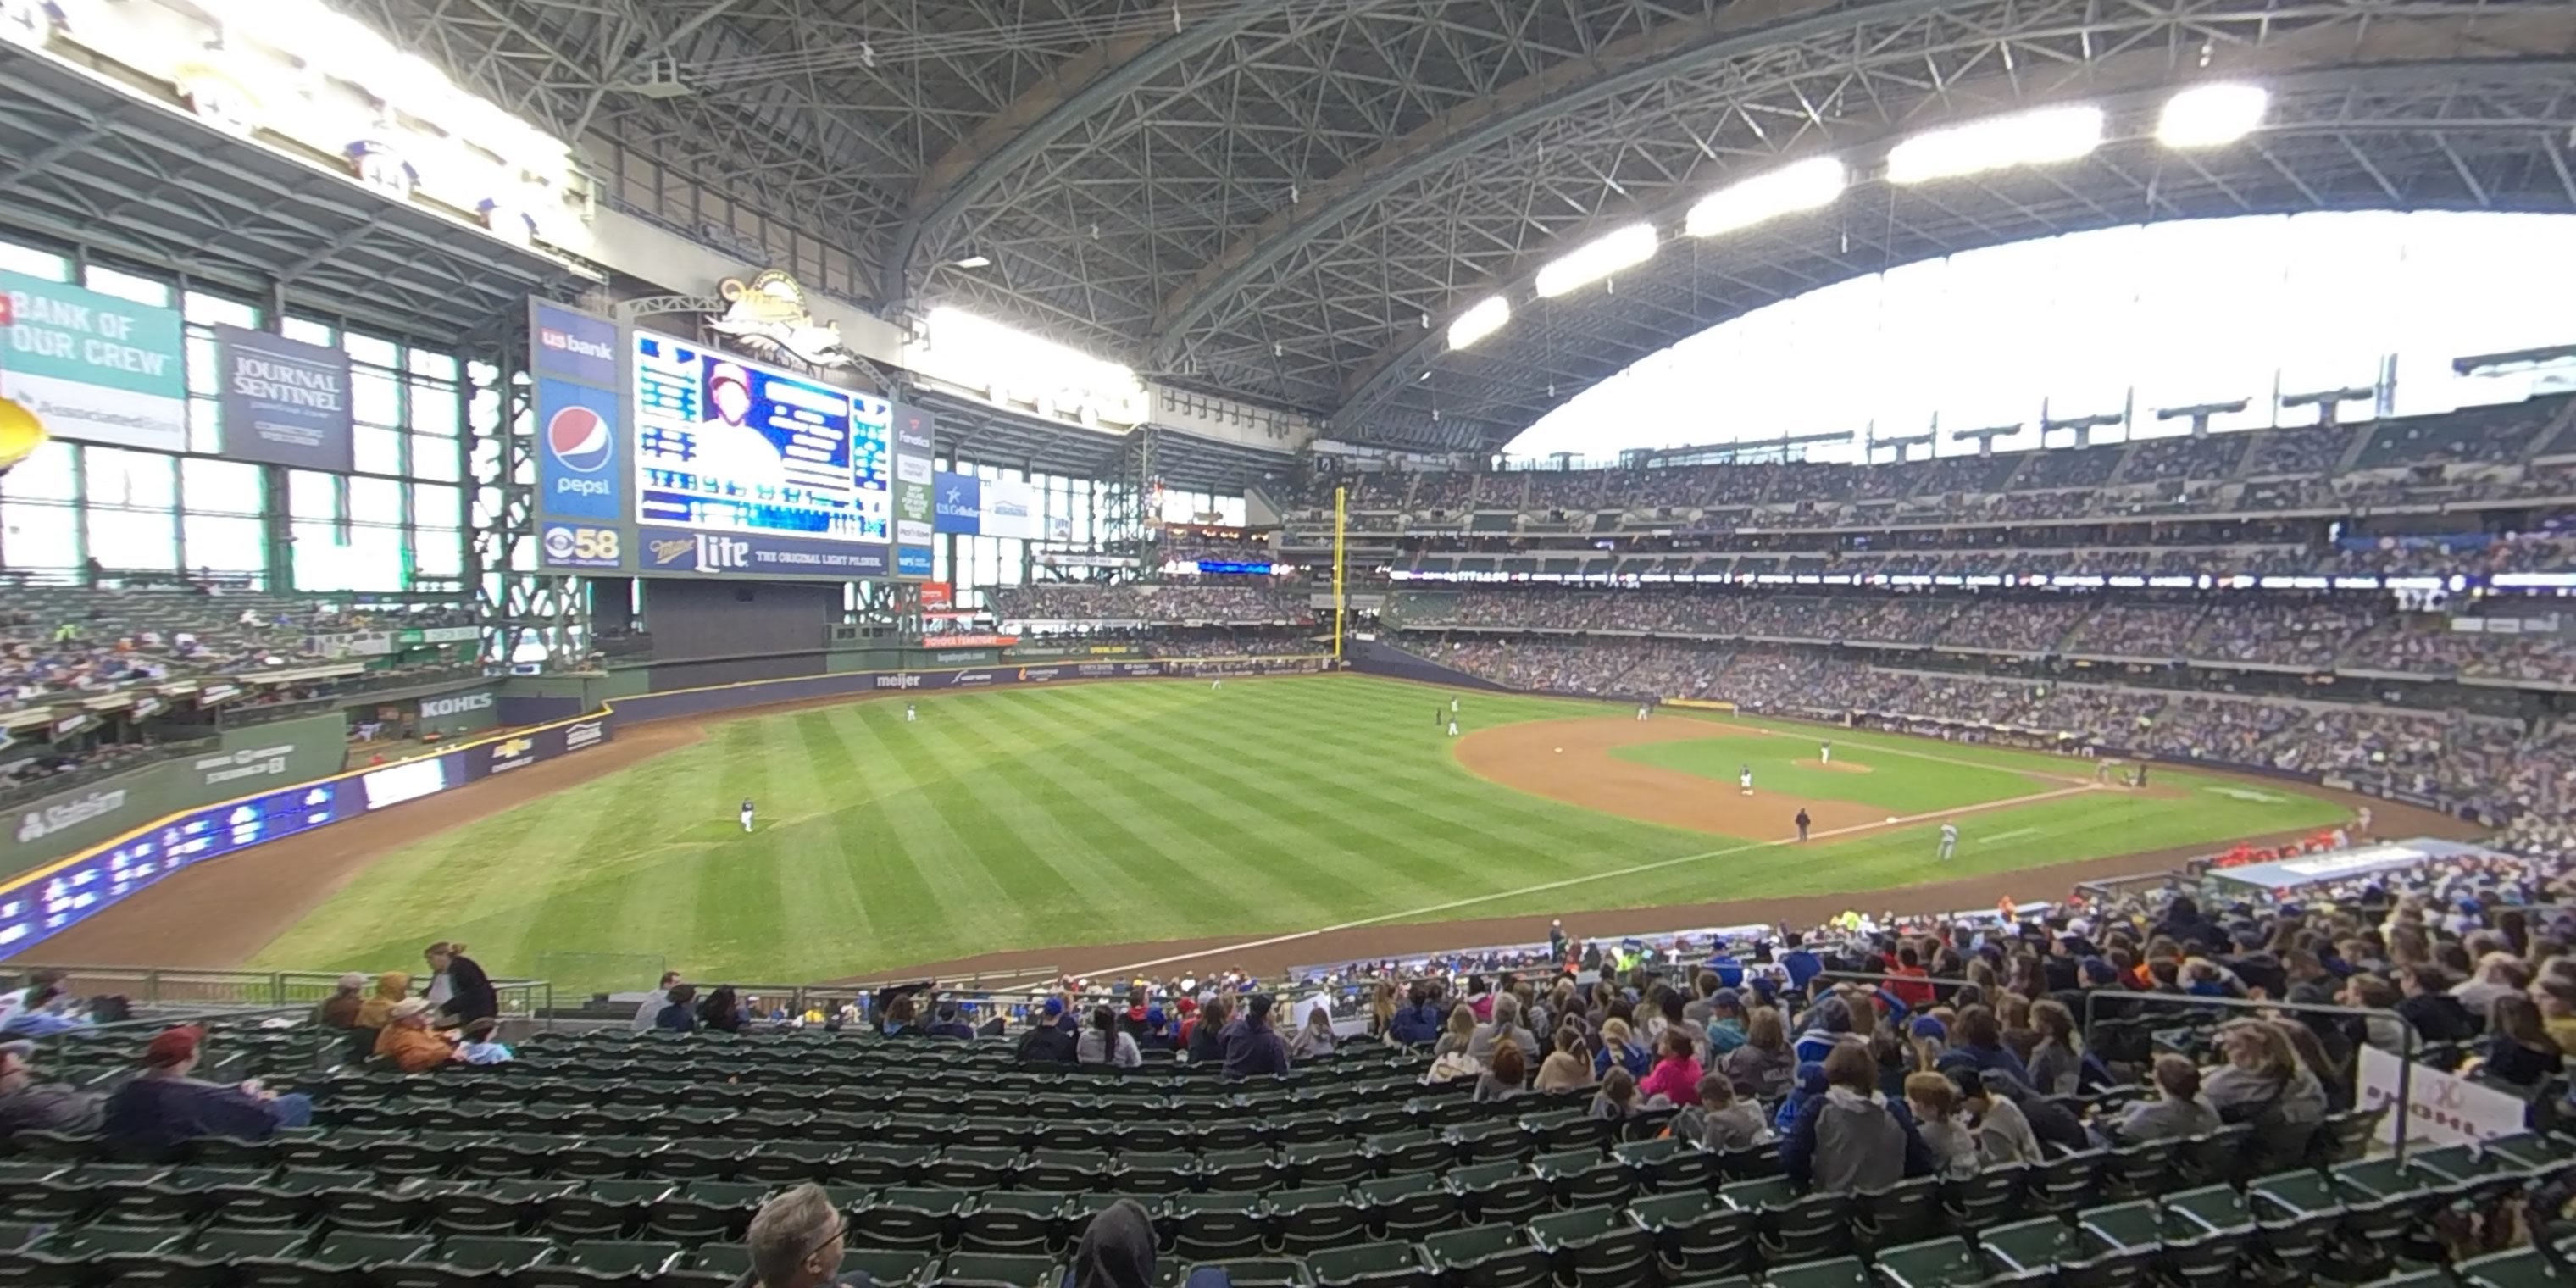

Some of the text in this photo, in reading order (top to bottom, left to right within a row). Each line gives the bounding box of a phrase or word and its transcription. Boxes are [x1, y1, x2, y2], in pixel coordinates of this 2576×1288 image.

[10, 290, 136, 340] BANK OF
[11, 323, 172, 376] OUR CREW
[234, 356, 341, 393] JOURNAL
[234, 376, 342, 412] SENTINEL
[557, 476, 611, 497] pepsi
[575, 528, 620, 559] 58
[693, 533, 749, 573] Lite
[755, 551, 777, 563] THE
[778, 552, 821, 564] ORIGINAL
[822, 555, 847, 566] LIGHT
[876, 674, 921, 690] meijer
